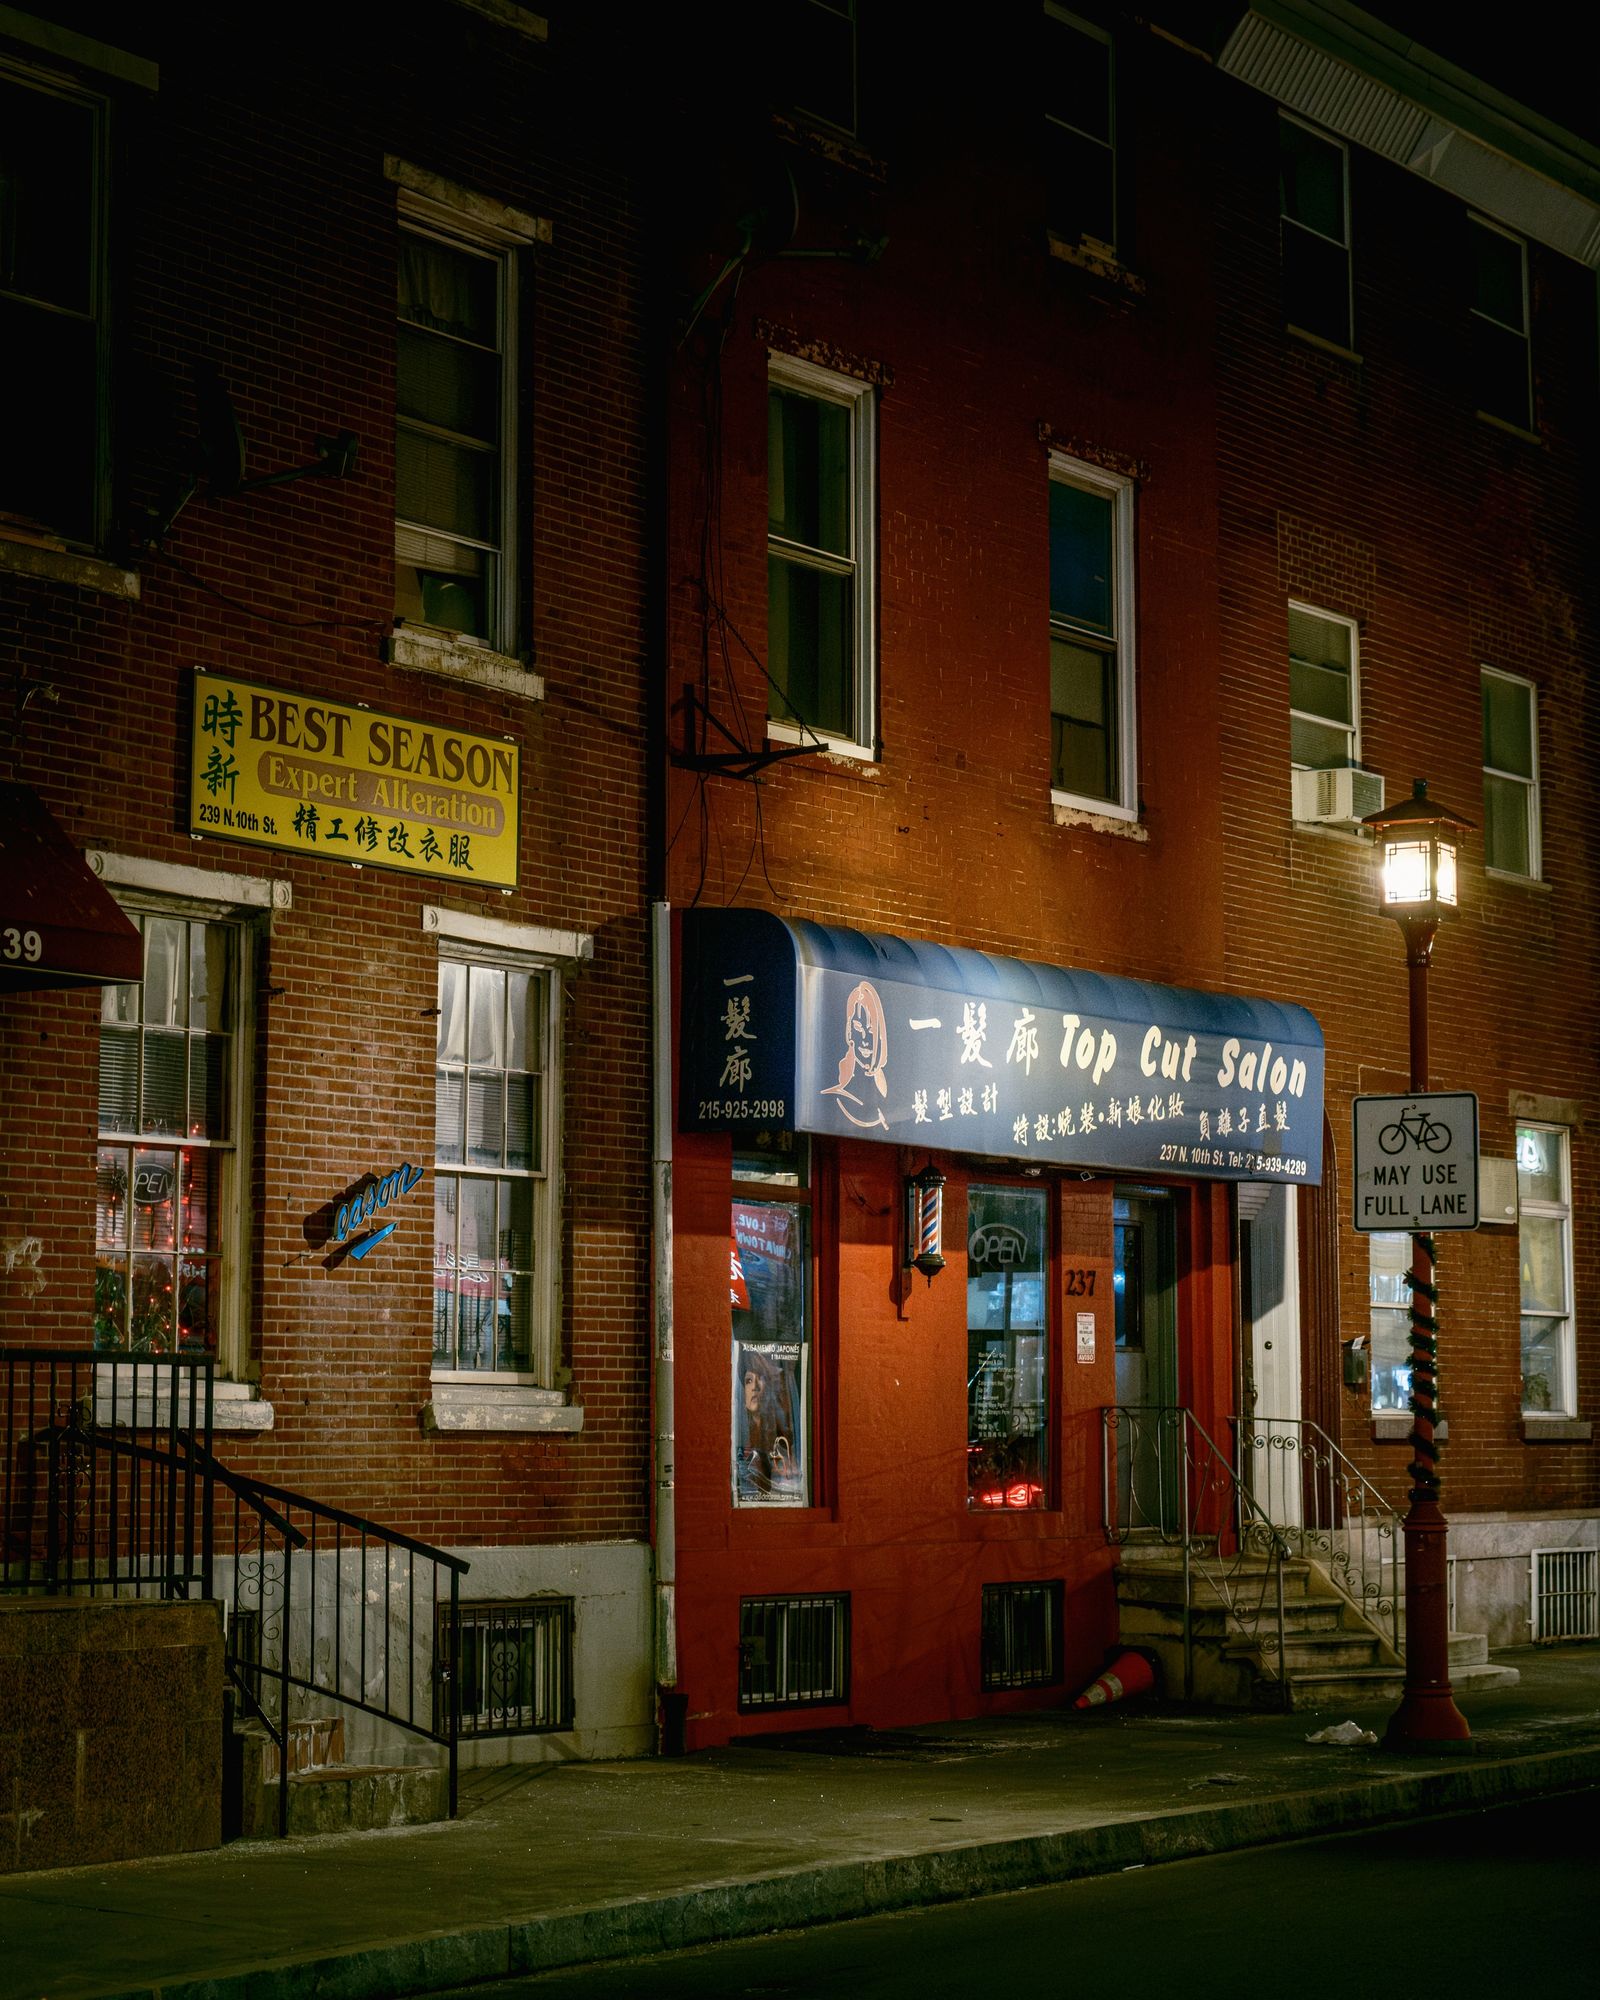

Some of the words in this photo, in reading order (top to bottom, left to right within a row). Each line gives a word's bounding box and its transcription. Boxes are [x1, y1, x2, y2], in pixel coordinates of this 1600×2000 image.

[200, 688, 243, 806] 時新
[249, 694, 352, 758] BEST
[368, 721, 515, 794] SEASON
[268, 755, 359, 802] Expert
[372, 778, 497, 830] Alteration
[199, 803, 220, 824] 239
[263, 816, 278, 835] St.
[292, 802, 475, 871] 精工修改衣服
[719, 974, 758, 1094] 一髮廊
[909, 1001, 1039, 1077] 一髮廊
[1059, 1014, 1117, 1085] Top
[1140, 1025, 1197, 1083] Cut
[1217, 1038, 1307, 1097] Salon
[699, 1099, 785, 1120] 215-925-2998
[911, 1082, 999, 1125] 髮型設計
[1160, 1144, 1178, 1161] 237
[1179, 1146, 1188, 1163] N.
[1191, 1147, 1210, 1165] 10th
[1212, 1151, 1225, 1167] St.
[1228, 1151, 1243, 1168] Tel:
[1374, 1165, 1410, 1185] MAY
[1422, 1164, 1457, 1184] USE
[1364, 1196, 1409, 1216] FULL
[1421, 1194, 1467, 1215] LANE
[970, 1235, 1028, 1264] OPEN
[1065, 1270, 1096, 1297] 237
